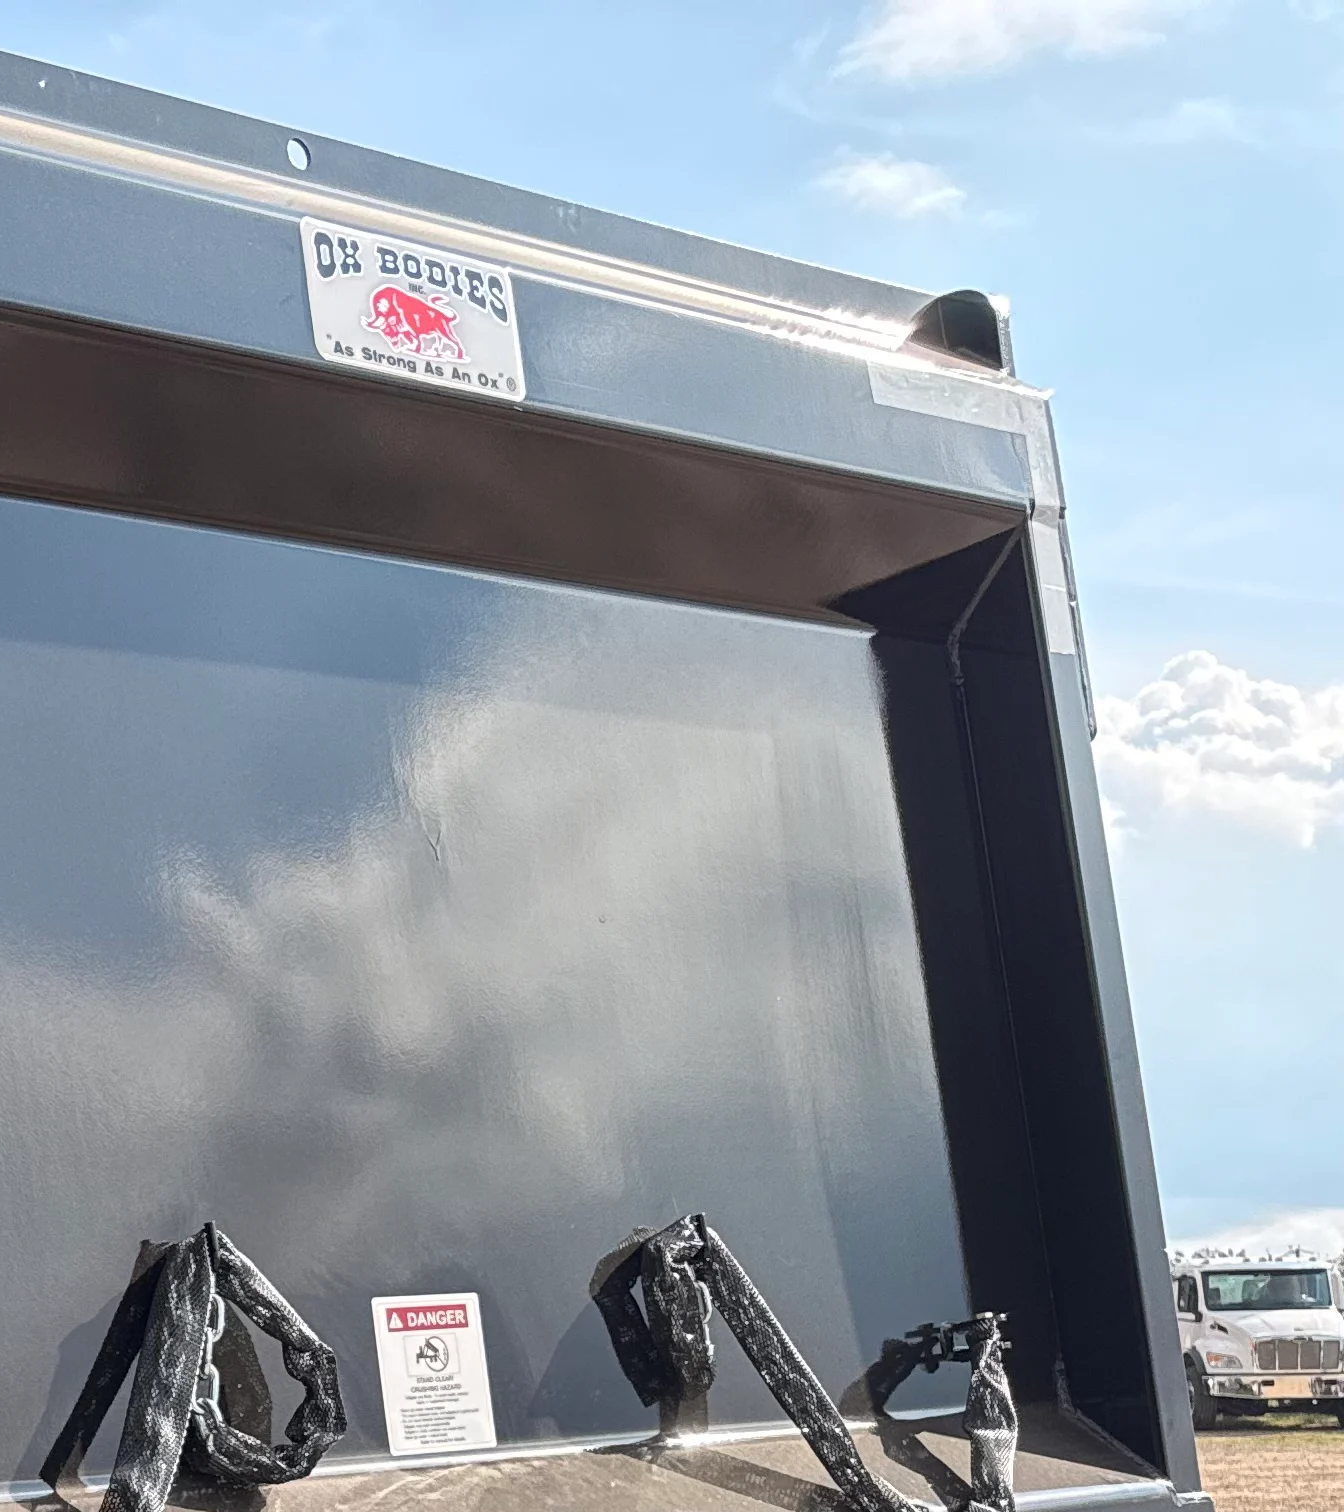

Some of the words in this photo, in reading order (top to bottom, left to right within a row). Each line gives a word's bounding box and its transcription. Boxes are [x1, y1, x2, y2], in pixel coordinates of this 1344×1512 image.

[313, 231, 363, 280] OX
[376, 245, 509, 325] BODIES
[361, 346, 417, 373] Strong
[424, 360, 444, 377] As
[451, 366, 472, 384] An
[406, 1308, 466, 1328] DANGER
